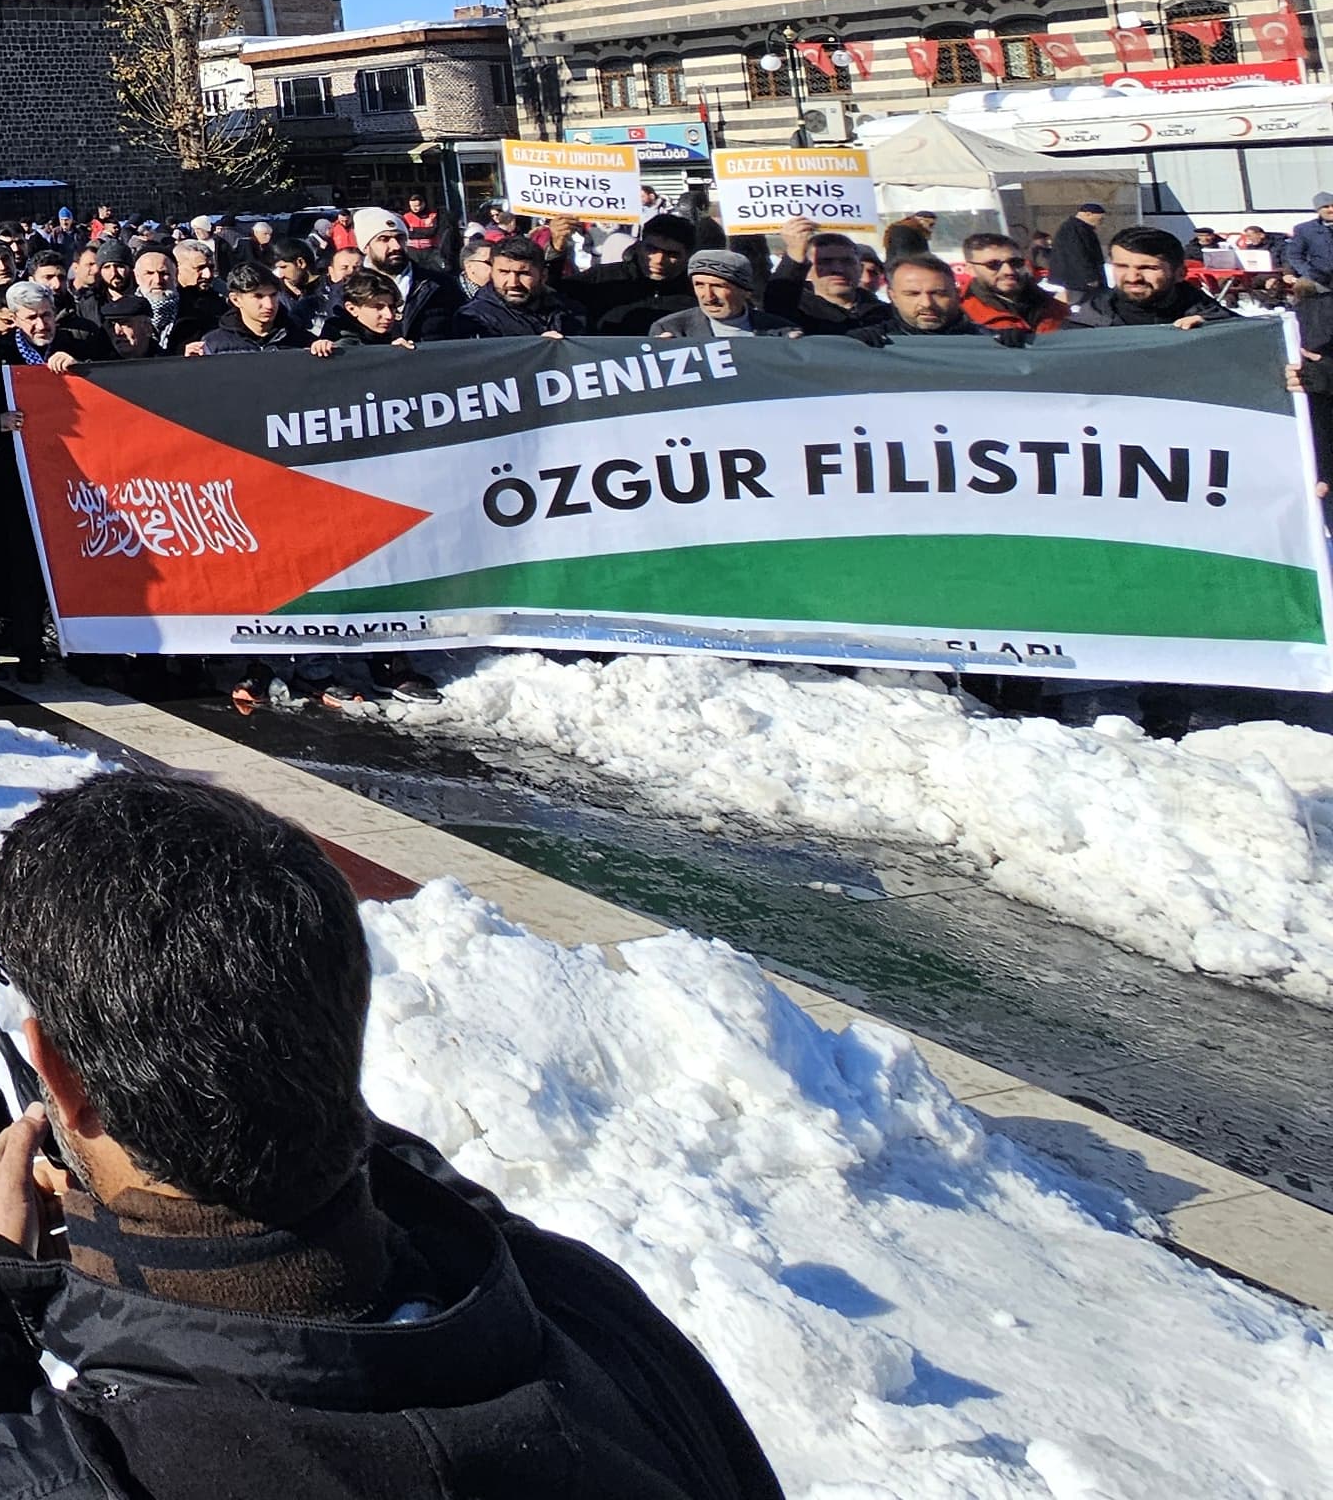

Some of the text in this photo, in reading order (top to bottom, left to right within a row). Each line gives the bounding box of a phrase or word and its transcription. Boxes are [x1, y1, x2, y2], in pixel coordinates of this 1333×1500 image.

[512, 149, 626, 169] GAZZE'Yİ UNUTMA
[727, 154, 859, 175] GAZZE'Yİ UNUTMA
[529, 171, 611, 193] DİRENİŞ
[748, 180, 845, 201] DİRENİŞ
[521, 188, 627, 210] SÜRÜYOR!
[738, 199, 862, 219] SÜRÜYOR!
[266, 339, 738, 449] NEHİR'DEN DENİZ'E
[482, 423, 1230, 529] ÖZGÜR FİLİSTİN!
